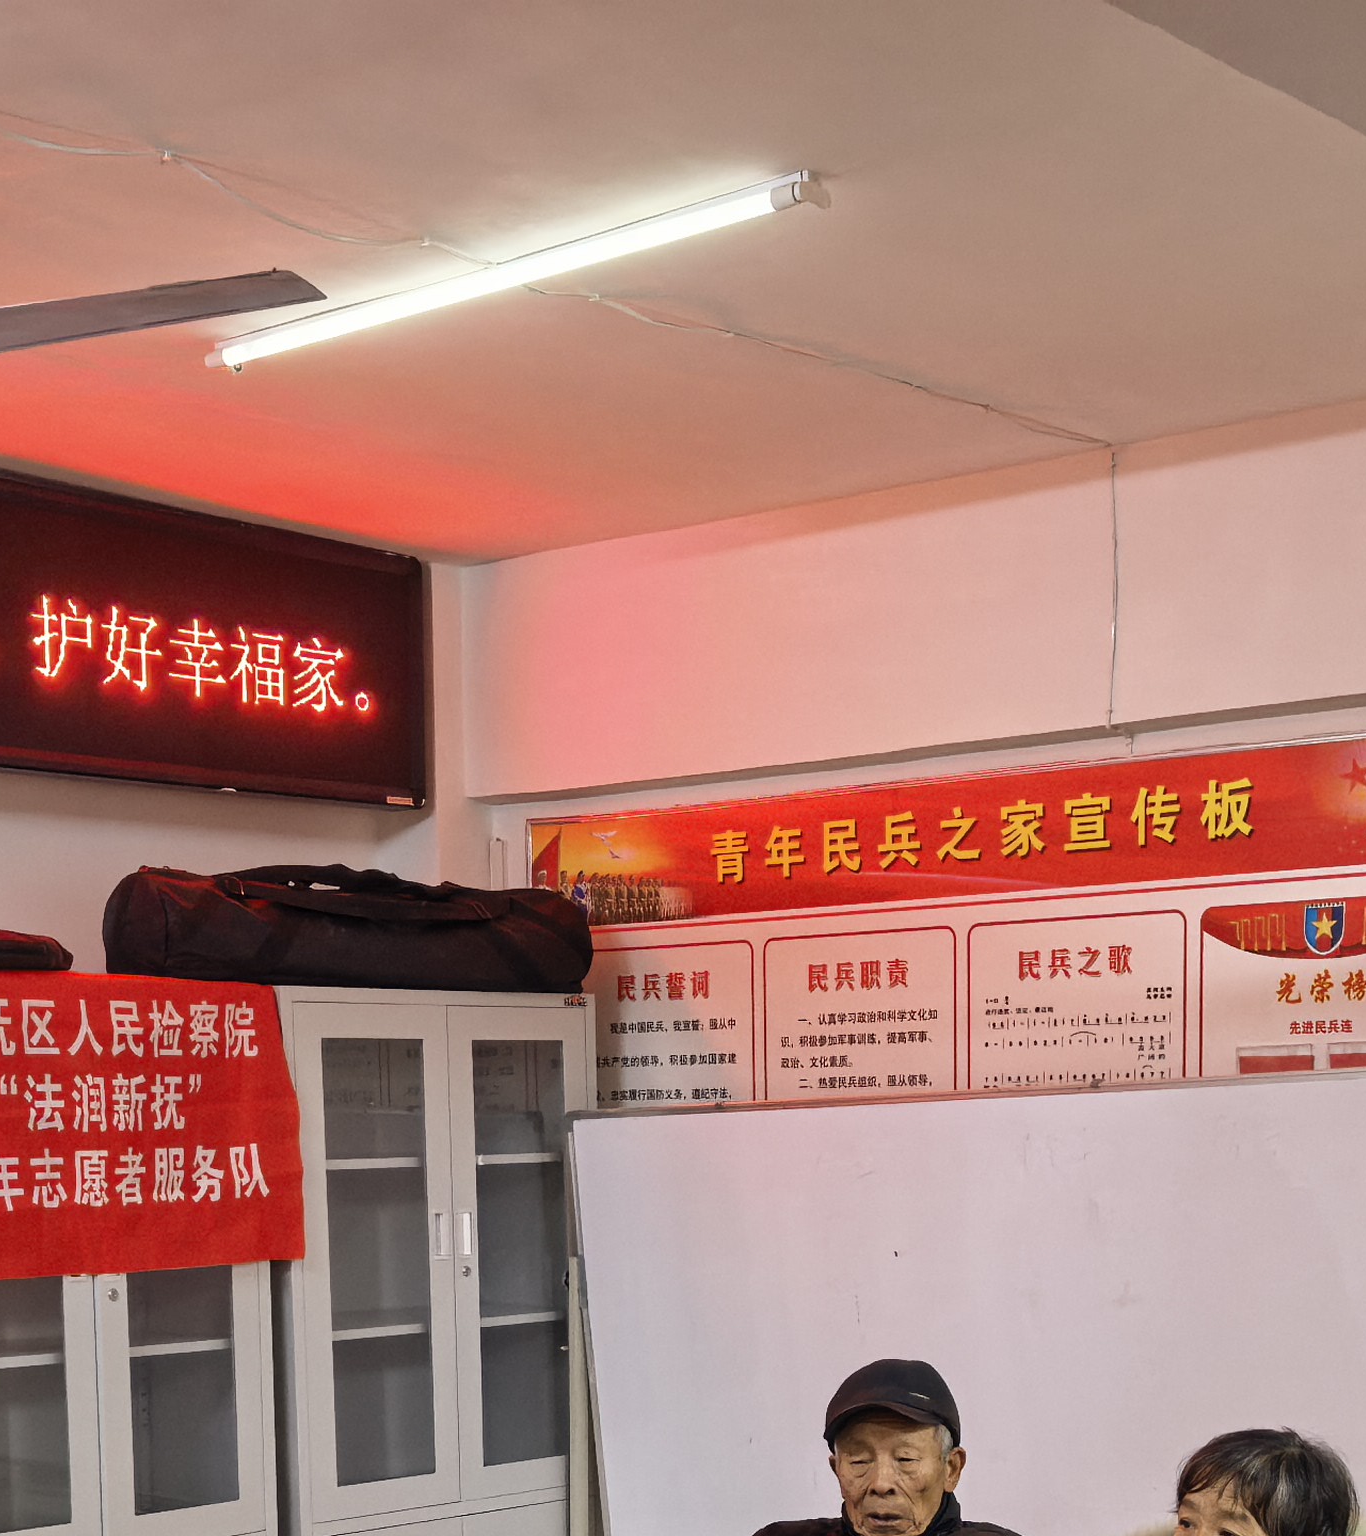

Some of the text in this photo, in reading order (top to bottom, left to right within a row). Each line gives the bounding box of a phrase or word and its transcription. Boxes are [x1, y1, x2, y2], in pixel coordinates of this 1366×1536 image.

[710, 777, 1255, 884] 青年民兵之家宣传板
[807, 958, 909, 993] 民兵职责
[1018, 944, 1133, 981] 民兵之歌
[617, 970, 711, 1002] 民兵誓词
[1289, 1019, 1353, 1035] 先进民兵连
[0, 1073, 203, 1133] “法润新抚”
